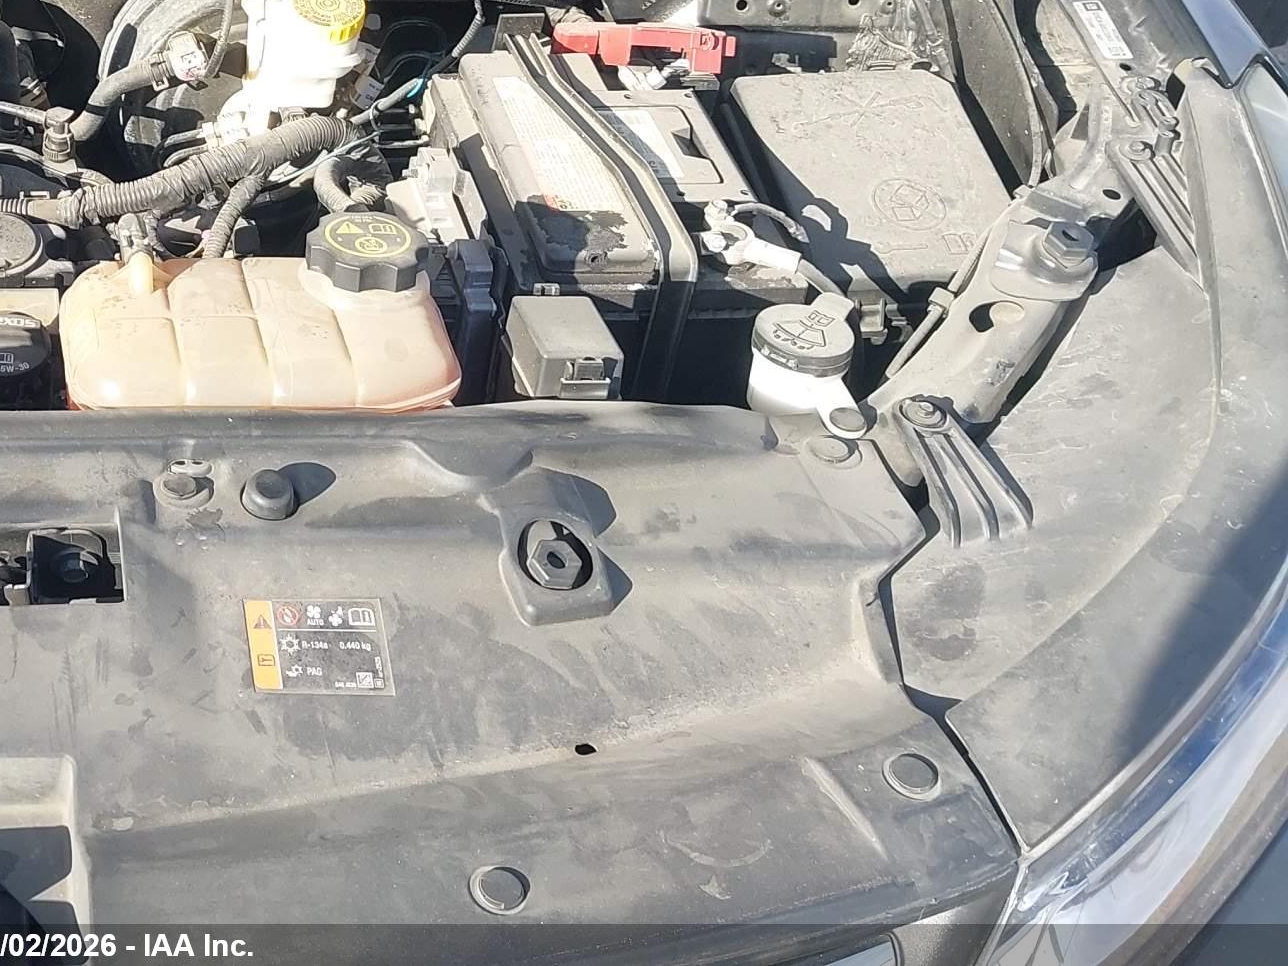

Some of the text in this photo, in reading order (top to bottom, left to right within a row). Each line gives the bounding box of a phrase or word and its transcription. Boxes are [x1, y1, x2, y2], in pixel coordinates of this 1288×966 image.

[0, 362, 30, 373] 5W-30
[307, 618, 324, 626] AUTO
[302, 640, 372, 652] R-134a 0.440 kg
[306, 667, 323, 676] PAG
